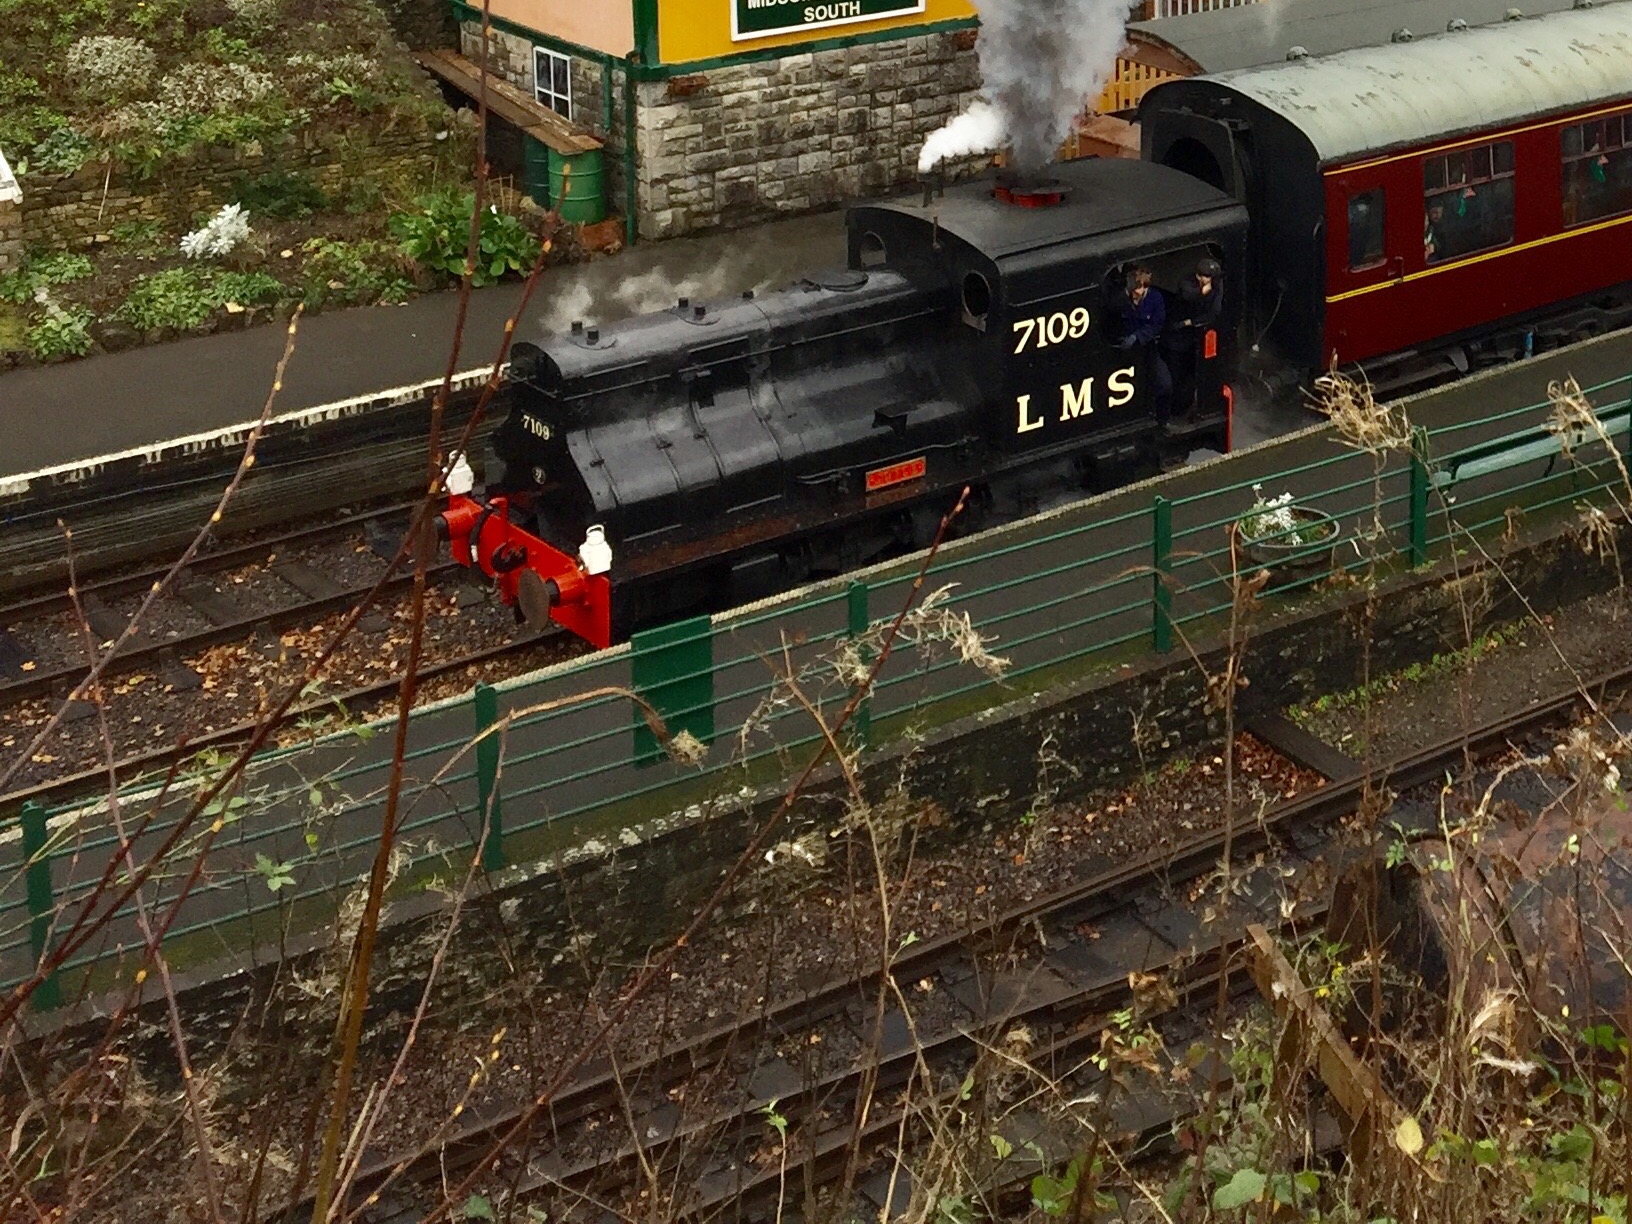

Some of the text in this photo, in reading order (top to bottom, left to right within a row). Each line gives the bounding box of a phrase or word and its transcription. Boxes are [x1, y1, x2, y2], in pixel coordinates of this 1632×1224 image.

[804, 0, 861, 22] SOUTH
[1013, 307, 1090, 354] 7109
[523, 414, 550, 441] 7109
